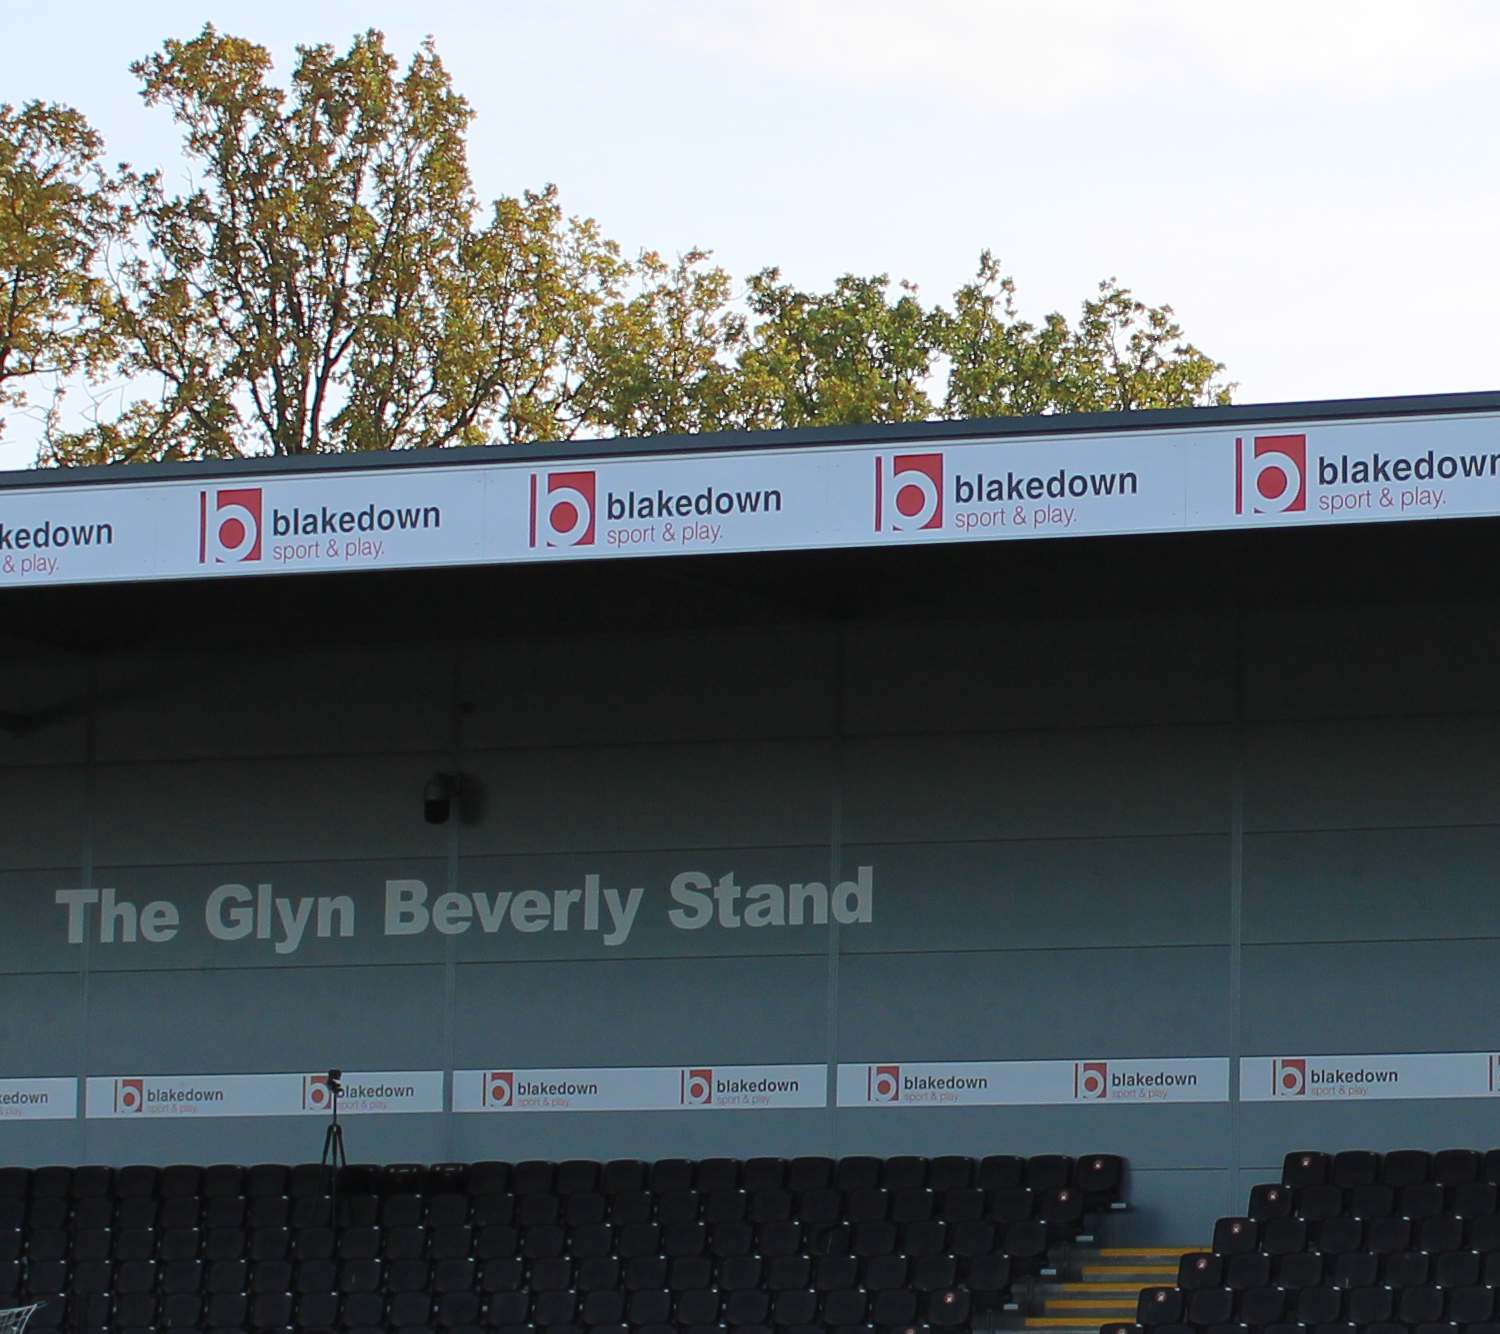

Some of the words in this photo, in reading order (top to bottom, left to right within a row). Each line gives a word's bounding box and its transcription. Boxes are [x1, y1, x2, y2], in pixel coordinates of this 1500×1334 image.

[956, 468, 1137, 504] blakedown
[607, 486, 781, 521] blakedown
[1319, 489, 1371, 515] sport
[1379, 487, 1394, 508] &
[1401, 486, 1445, 512] play.
[273, 503, 440, 537] blakedown
[955, 507, 1005, 532] sport
[1013, 505, 1027, 526] &
[1034, 504, 1076, 530] play.
[607, 525, 655, 549] sport
[662, 522, 675, 542] &
[682, 520, 722, 545] play.
[273, 541, 320, 565] sport
[326, 538, 339, 558] &
[346, 536, 384, 561] play.
[3, 554, 15, 573] &
[21, 554, 59, 577] play.
[55, 888, 179, 944] The
[205, 884, 355, 954] Glyn
[384, 874, 644, 946] Beverly
[668, 866, 874, 931] Stand
[518, 1081, 597, 1096] blakedown
[717, 1078, 798, 1093] blakedown
[905, 1075, 987, 1090] blakedown
[1112, 1071, 1196, 1087] blakedown
[1311, 1068, 1398, 1084] blakedown
[149, 1088, 223, 1102] blakedown
